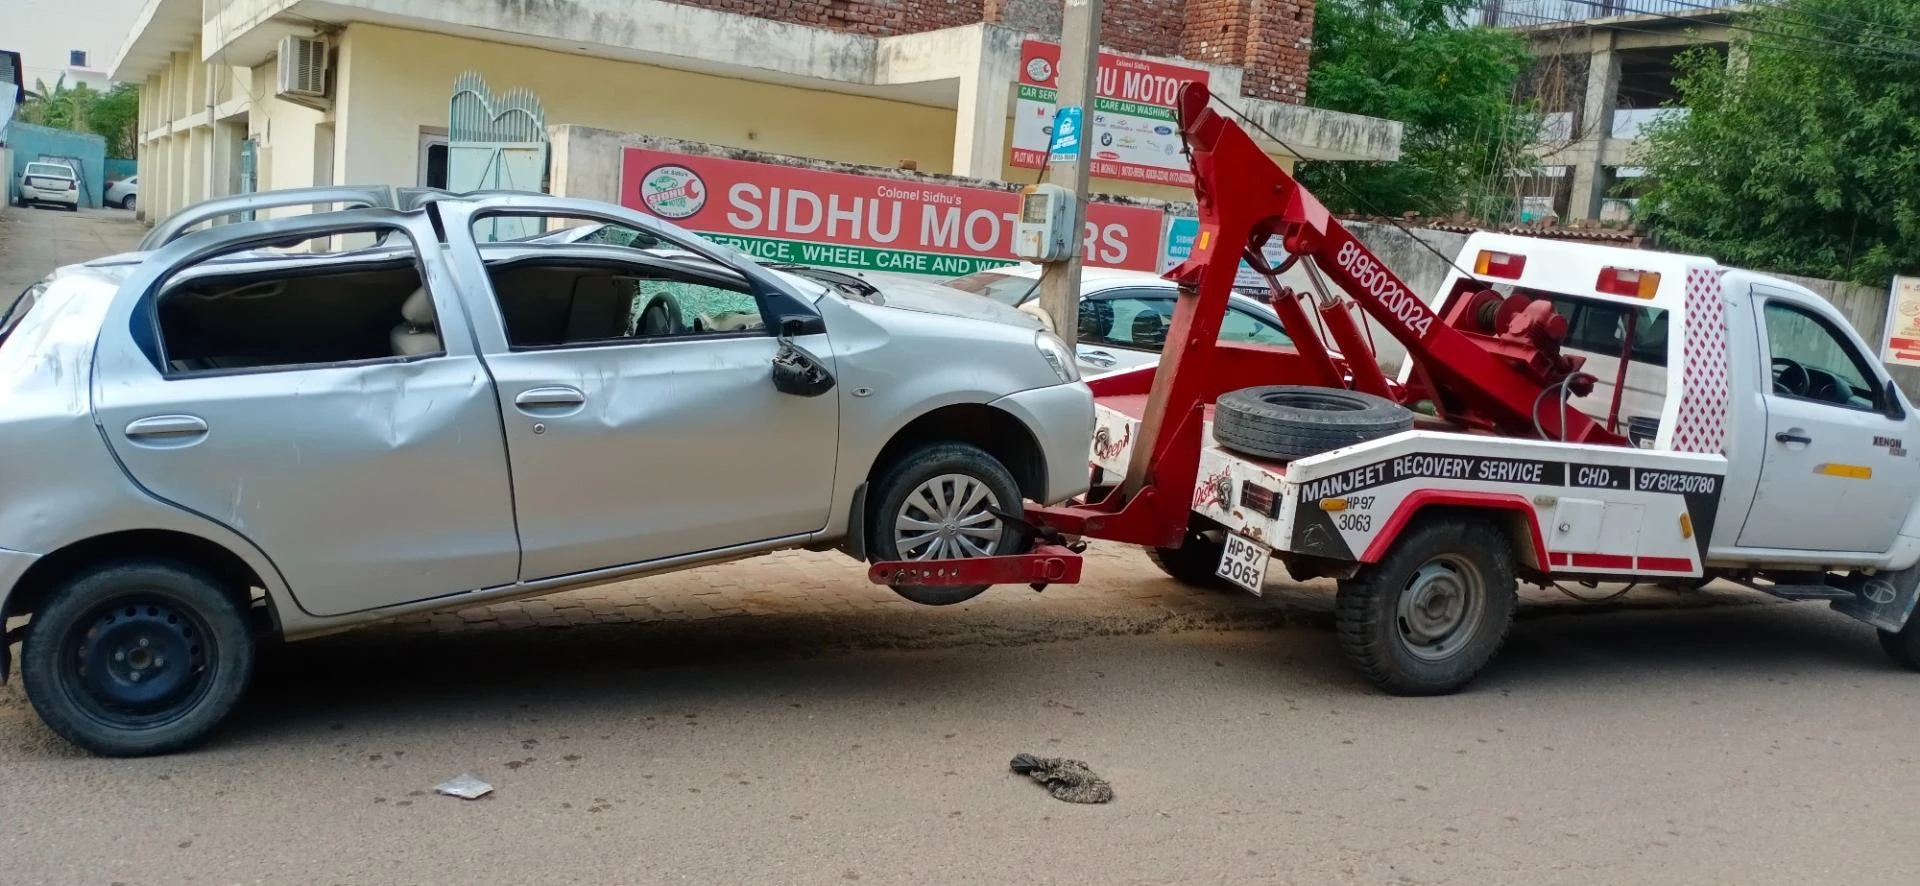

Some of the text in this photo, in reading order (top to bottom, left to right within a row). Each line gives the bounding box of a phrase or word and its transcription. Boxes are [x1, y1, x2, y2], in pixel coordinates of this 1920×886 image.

[1021, 87, 1037, 98] CAR
[1122, 70, 1192, 105] MOTO
[1100, 100, 1118, 110] CARE
[1120, 103, 1136, 113] AND
[1137, 106, 1169, 118] WASHING
[647, 187, 686, 206] SIDHU
[877, 185, 962, 205] Colonel Sidhu's
[727, 182, 1129, 264] SIDHU MOTRS
[802, 245, 870, 266] WHEEL
[876, 252, 927, 270] CARE
[932, 257, 970, 274] AND
[1337, 240, 1434, 339] 8195020024
[1872, 435, 1902, 449] XENON
[1301, 455, 1544, 503] MANJEET RECOVERY SERVICE
[1639, 472, 1716, 494] 9781230780
[1338, 513, 1371, 532] 3063
[1220, 556, 1260, 588] 3063
